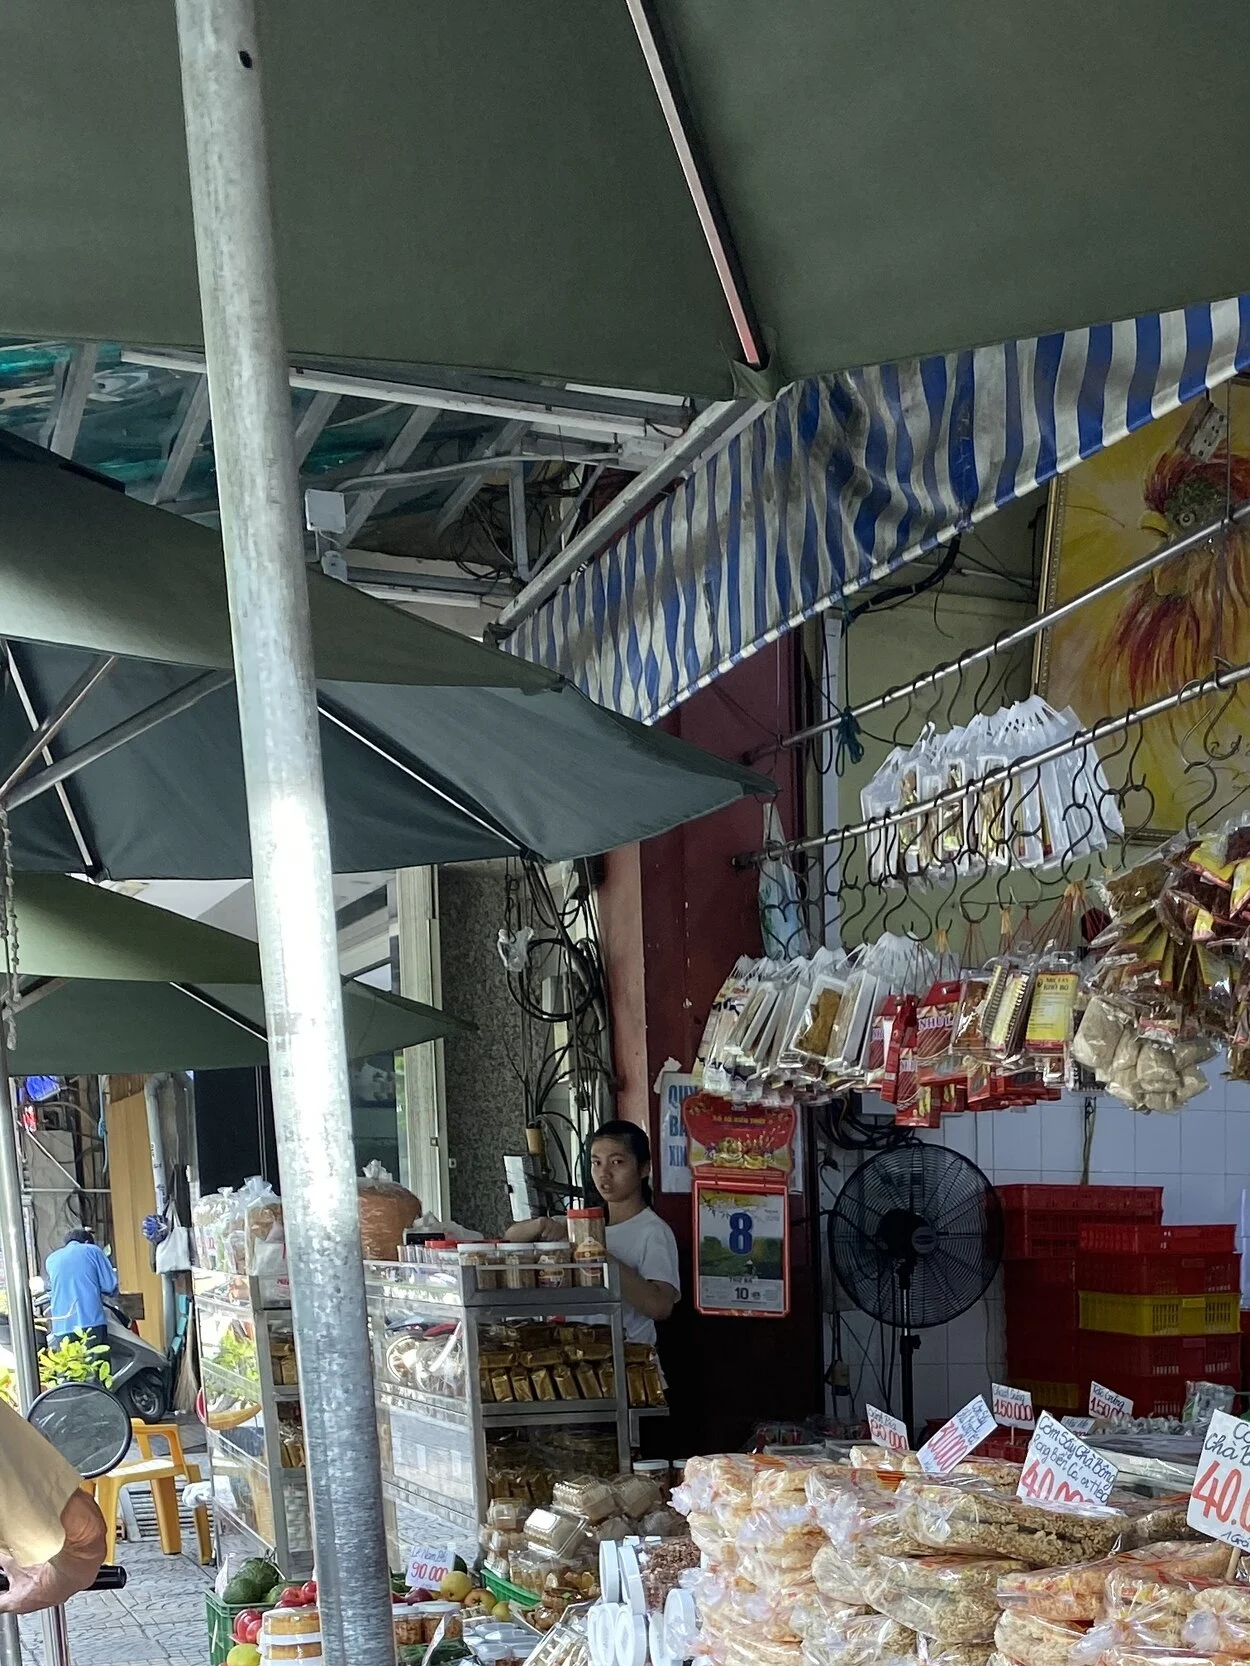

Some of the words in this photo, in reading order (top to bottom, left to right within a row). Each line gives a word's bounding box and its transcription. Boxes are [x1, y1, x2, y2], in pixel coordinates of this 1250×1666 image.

[729, 1212, 753, 1255] 8
[735, 1287, 749, 1300] 10
[1204, 1432, 1239, 1460] Chà
